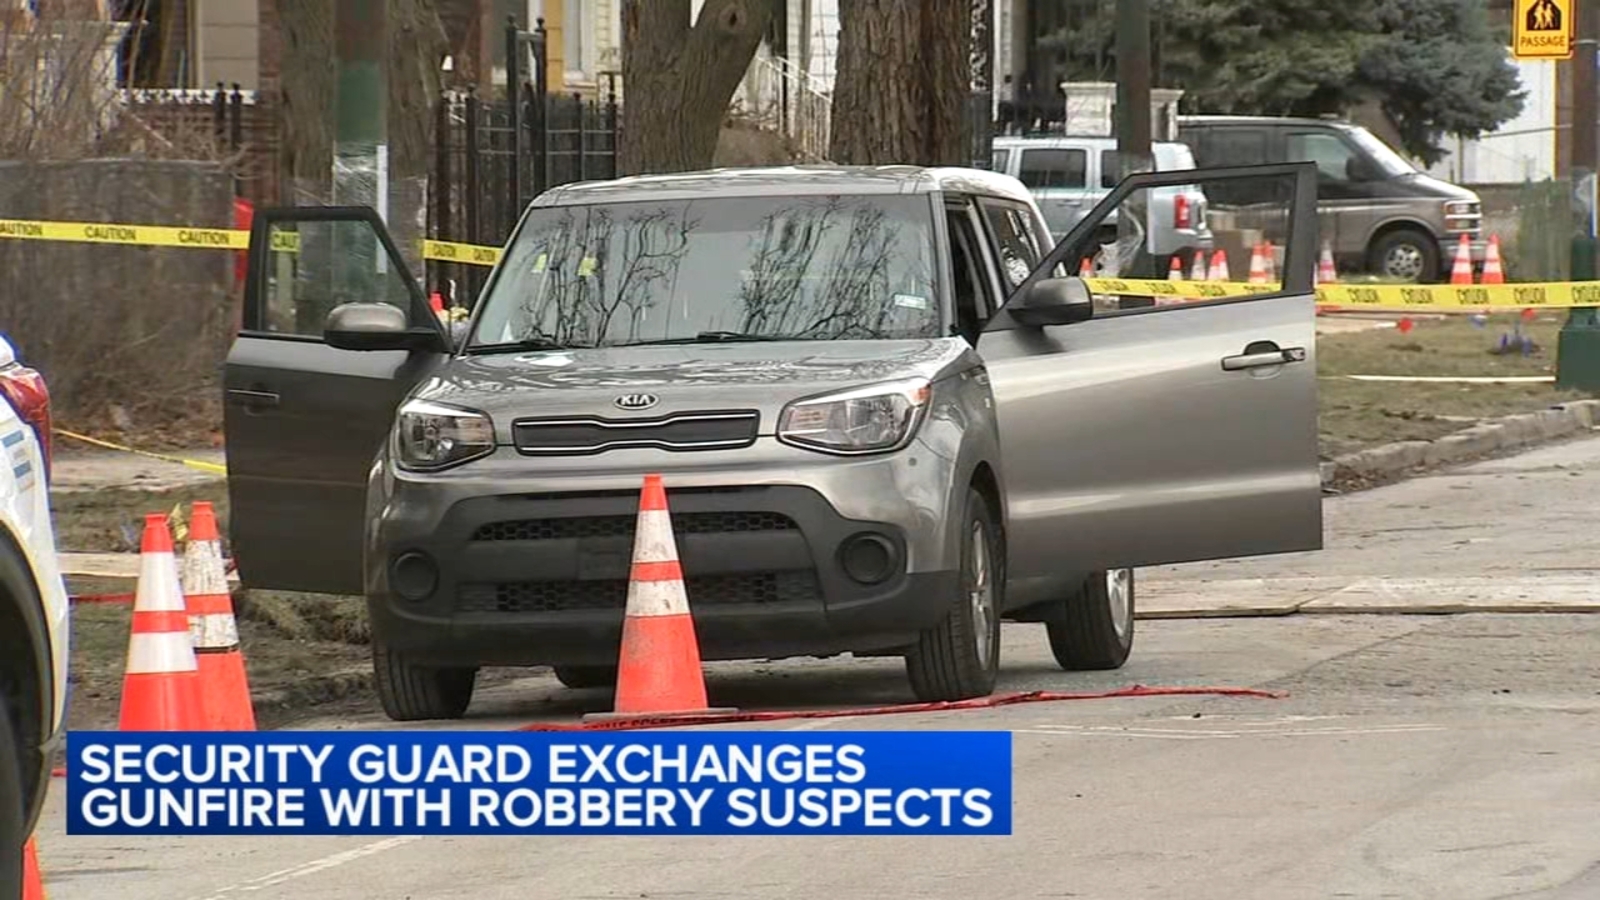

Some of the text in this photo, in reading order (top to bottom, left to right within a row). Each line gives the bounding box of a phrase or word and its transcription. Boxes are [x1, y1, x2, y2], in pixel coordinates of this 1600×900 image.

[1519, 35, 1566, 47] PASSAGE
[0, 222, 230, 245] AUTION CAUTION CAUTION
[620, 394, 651, 406] KIA
